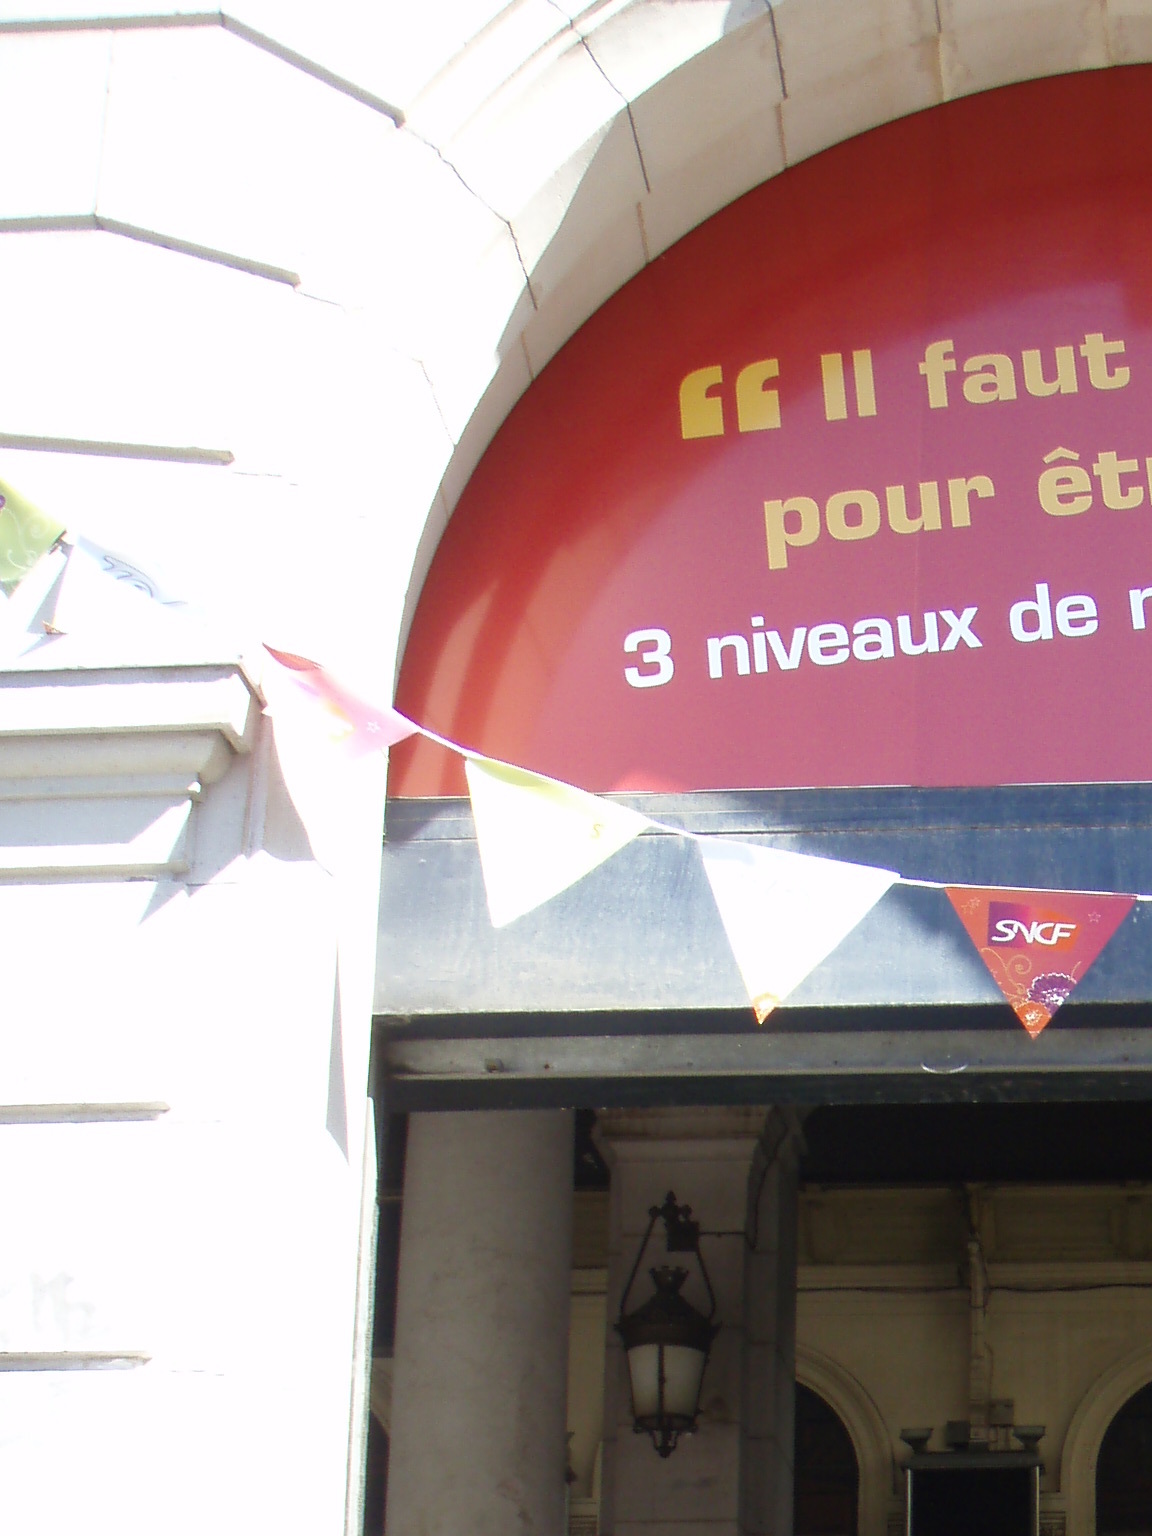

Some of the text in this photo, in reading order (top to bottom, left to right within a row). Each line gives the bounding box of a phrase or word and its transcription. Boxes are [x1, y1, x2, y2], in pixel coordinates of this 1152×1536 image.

[820, 348, 879, 423] Il
[917, 331, 1132, 410] faut
[762, 473, 997, 572] pour
[621, 627, 676, 693] 3
[705, 605, 985, 681] niveaux
[1007, 581, 1100, 644] de
[990, 918, 1078, 947] SNCF
